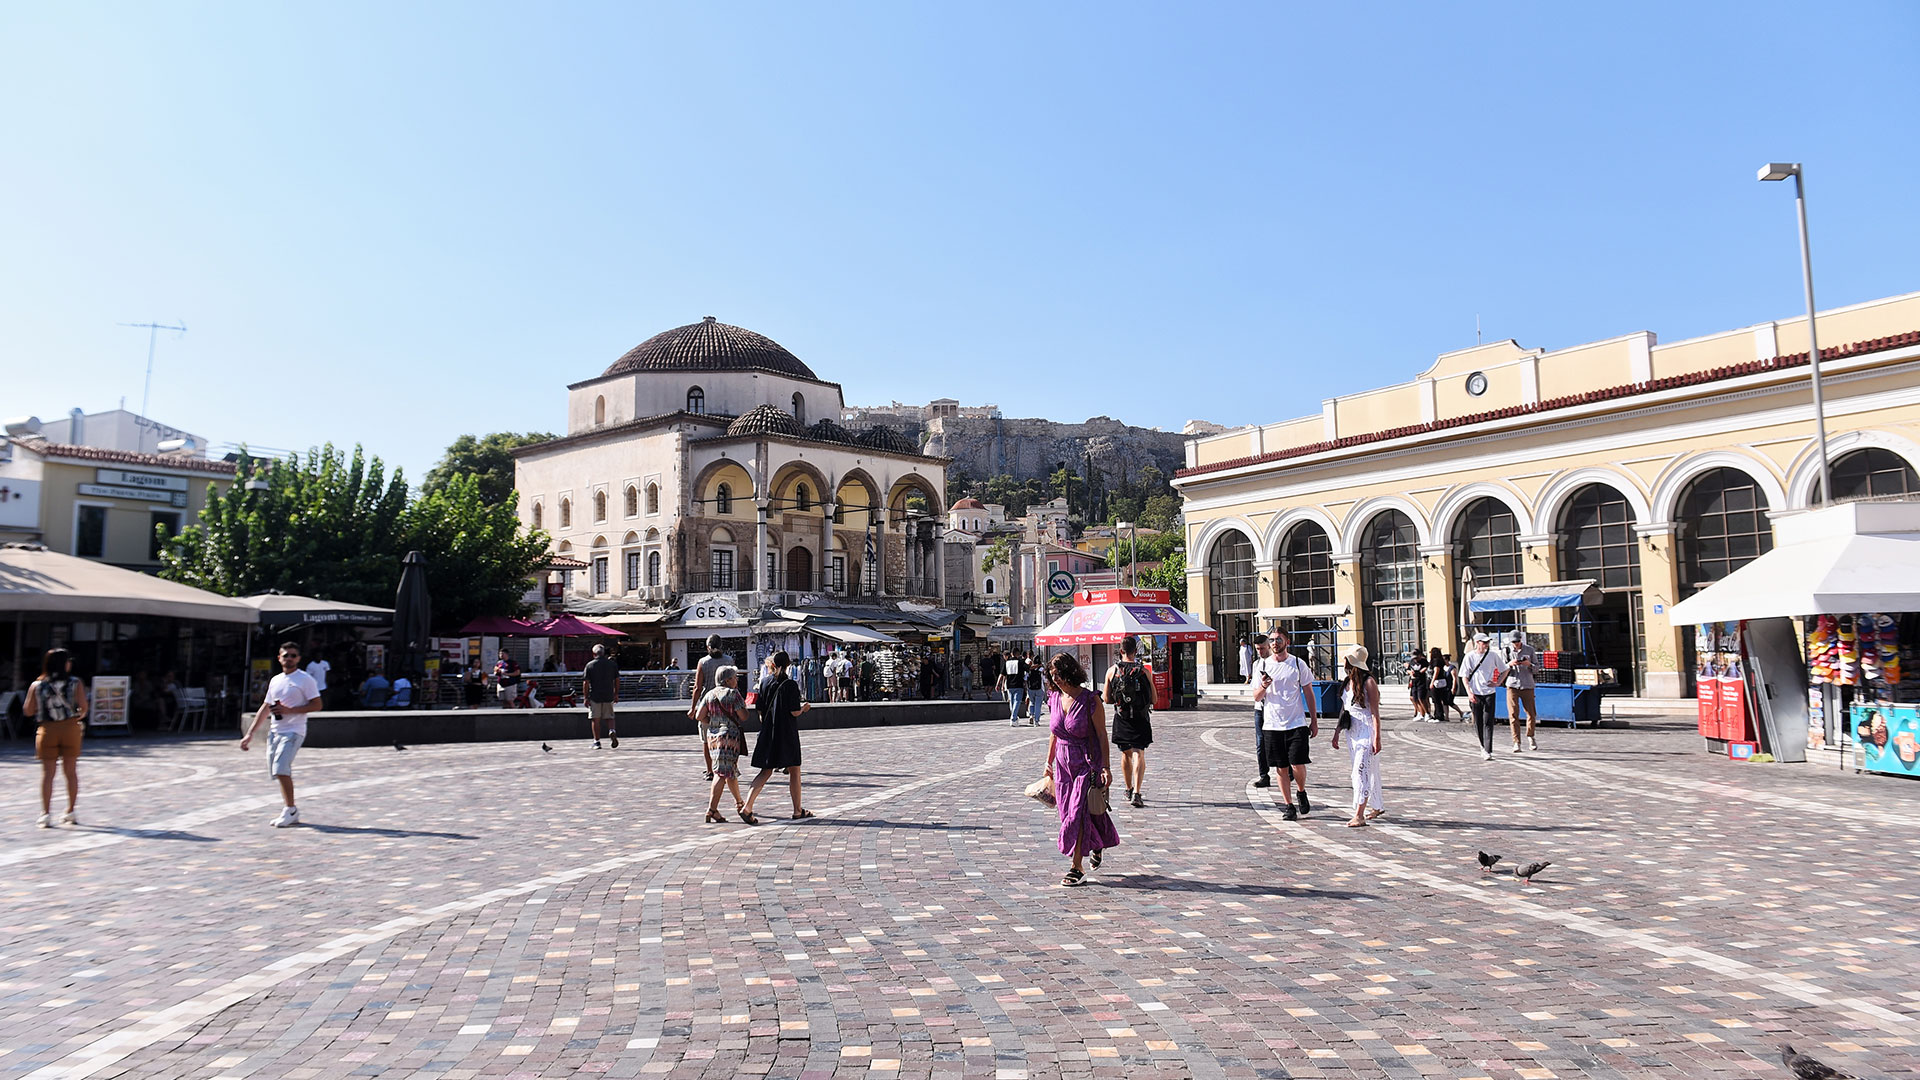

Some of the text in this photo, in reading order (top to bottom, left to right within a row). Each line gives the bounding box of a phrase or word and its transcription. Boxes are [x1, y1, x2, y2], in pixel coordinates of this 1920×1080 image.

[121, 472, 166, 485] Lagom
[303, 613, 338, 623] Lagom
[696, 606, 727, 618] GES
